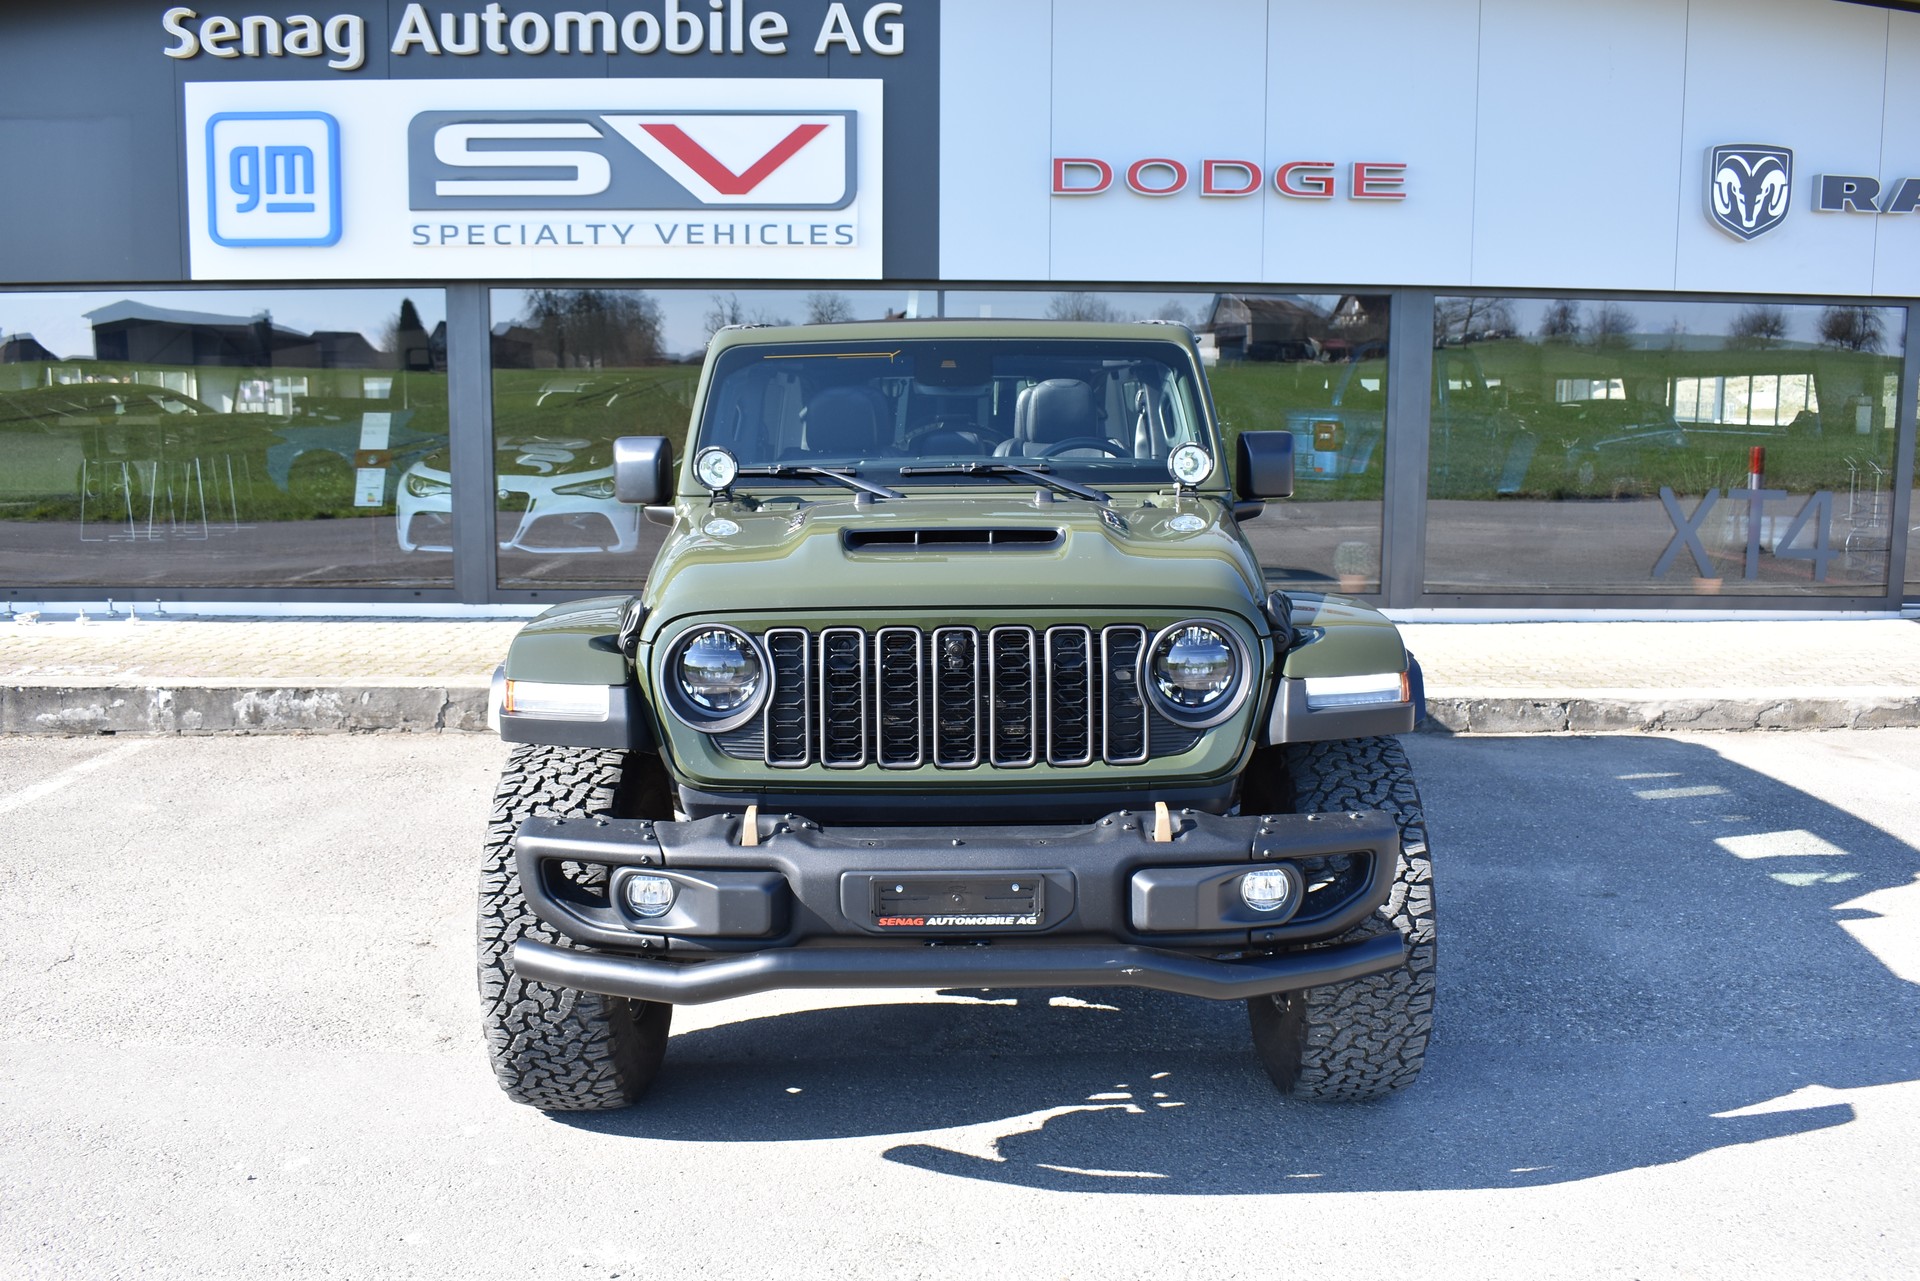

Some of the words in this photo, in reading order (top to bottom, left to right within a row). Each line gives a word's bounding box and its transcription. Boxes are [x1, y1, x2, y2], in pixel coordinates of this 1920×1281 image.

[162, 7, 366, 71] Senag
[391, 0, 789, 56] Automobile
[814, 2, 904, 56] AG
[229, 145, 315, 213] gm
[1050, 157, 1407, 200] DODGE
[412, 224, 635, 246] SPECIALTY
[654, 223, 854, 246] VEHICLES
[1651, 486, 1839, 582] XT4
[878, 917, 925, 926] SENAG
[926, 916, 1015, 926] AUTOMOBILE
[1016, 916, 1037, 925] AG
